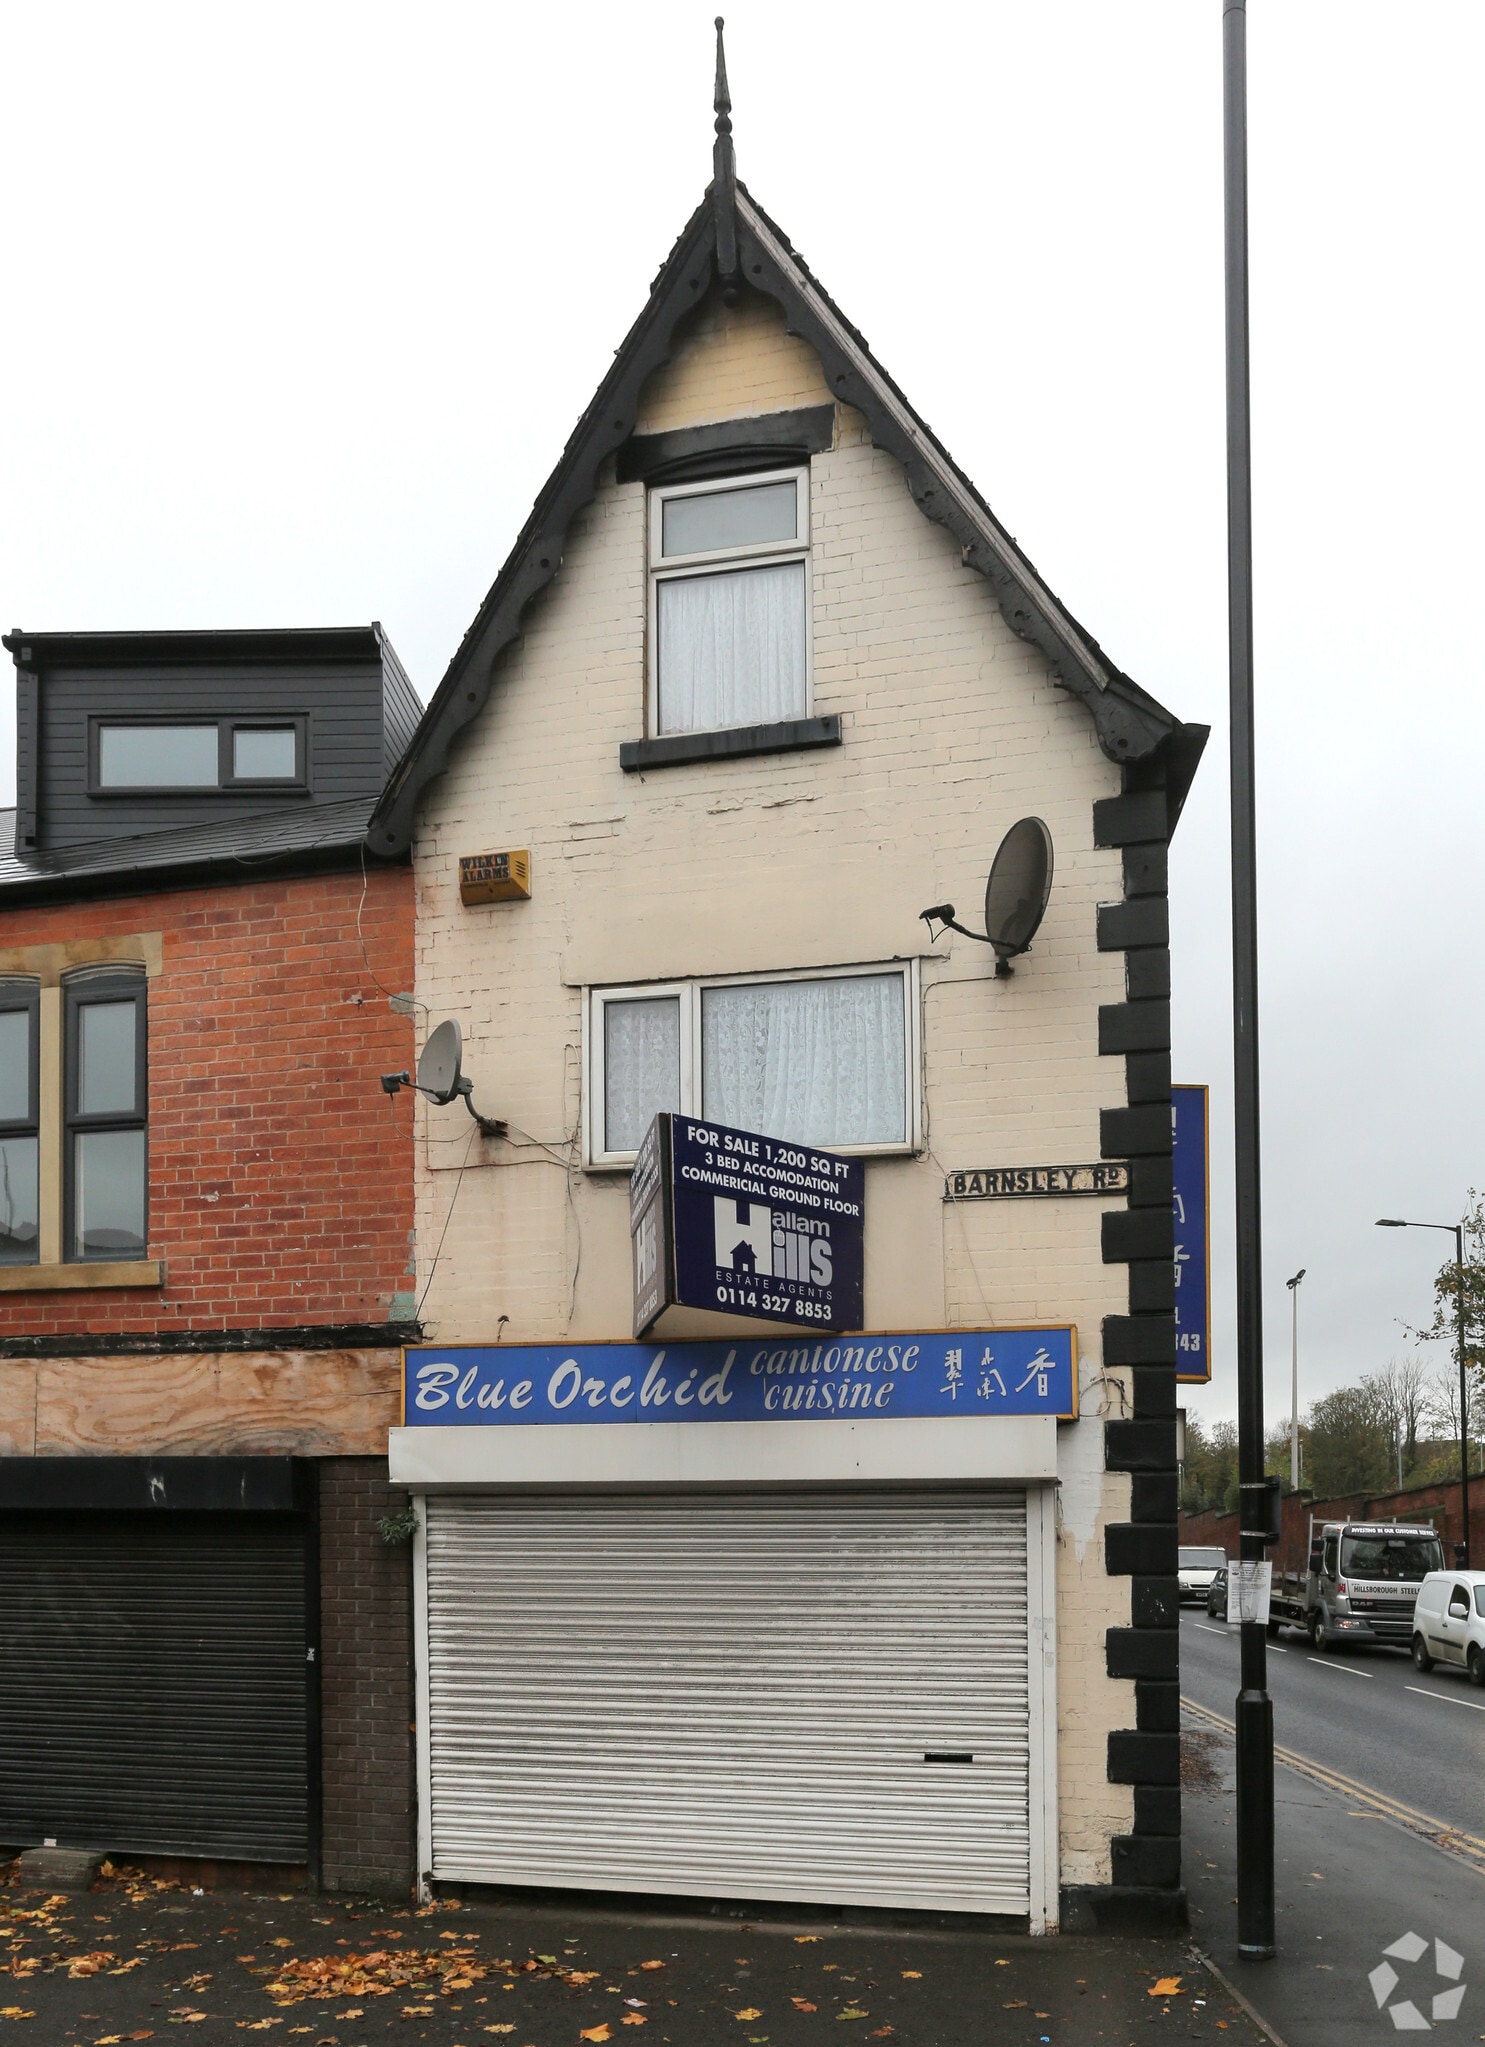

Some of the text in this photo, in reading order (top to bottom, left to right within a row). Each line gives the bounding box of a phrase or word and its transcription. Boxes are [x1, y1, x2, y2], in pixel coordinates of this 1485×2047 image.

[687, 1125, 850, 1179] FOR SALE 1,200 SQ FT
[705, 1152, 840, 1194] 3 BED ACCOMODATION
[954, 1169, 1077, 1195] BARNSLEY
[681, 1165, 767, 1196] COMMERICIAL
[769, 1185, 821, 1208] GROUND
[823, 1197, 860, 1217] FLOOR
[715, 1270, 833, 1300] ESTATE AGENTS
[716, 1286, 832, 1321] 0114 327 8853
[750, 1345, 920, 1376] cantonese
[414, 1349, 737, 1411] Blue Orchid
[764, 1378, 895, 1411] cuisine
[1353, 1585, 1398, 1594] HILLSBOROUGH
